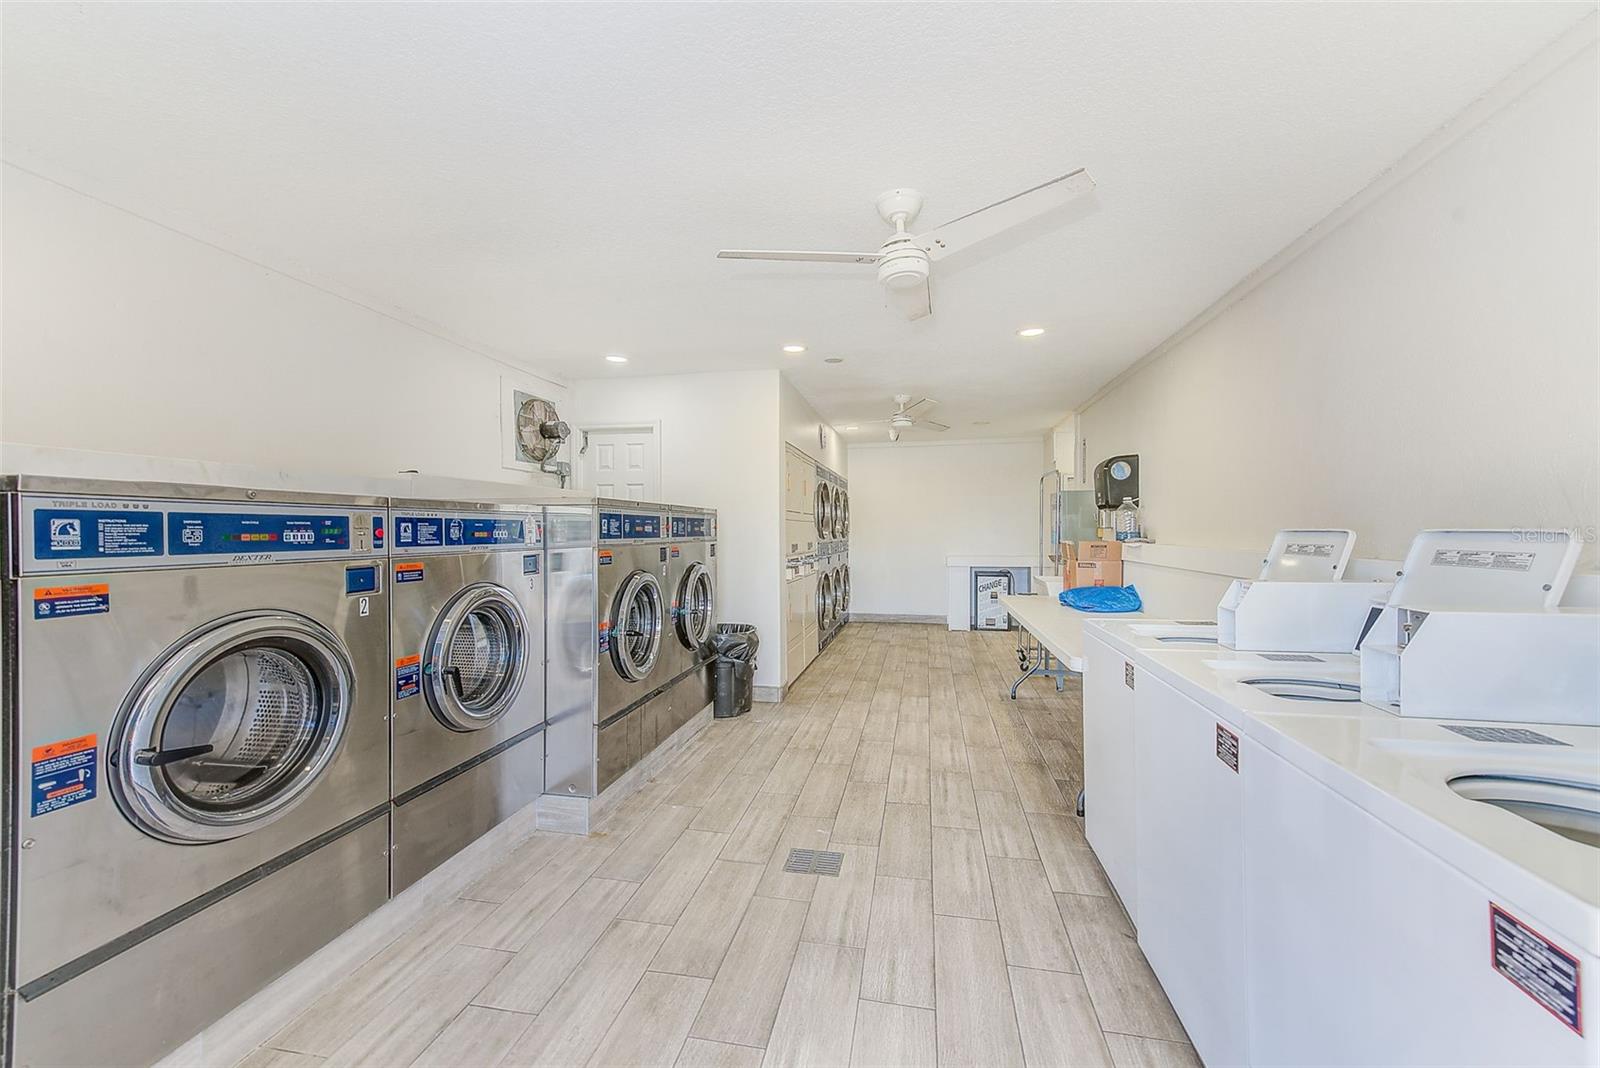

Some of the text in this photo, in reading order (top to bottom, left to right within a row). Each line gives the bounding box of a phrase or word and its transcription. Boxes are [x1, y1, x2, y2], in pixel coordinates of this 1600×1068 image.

[52, 500, 118, 509] TRIPLE LOAD
[232, 554, 273, 562] DEXTER
[979, 579, 1002, 592] CHANGE
[360, 598, 368, 615] 2
